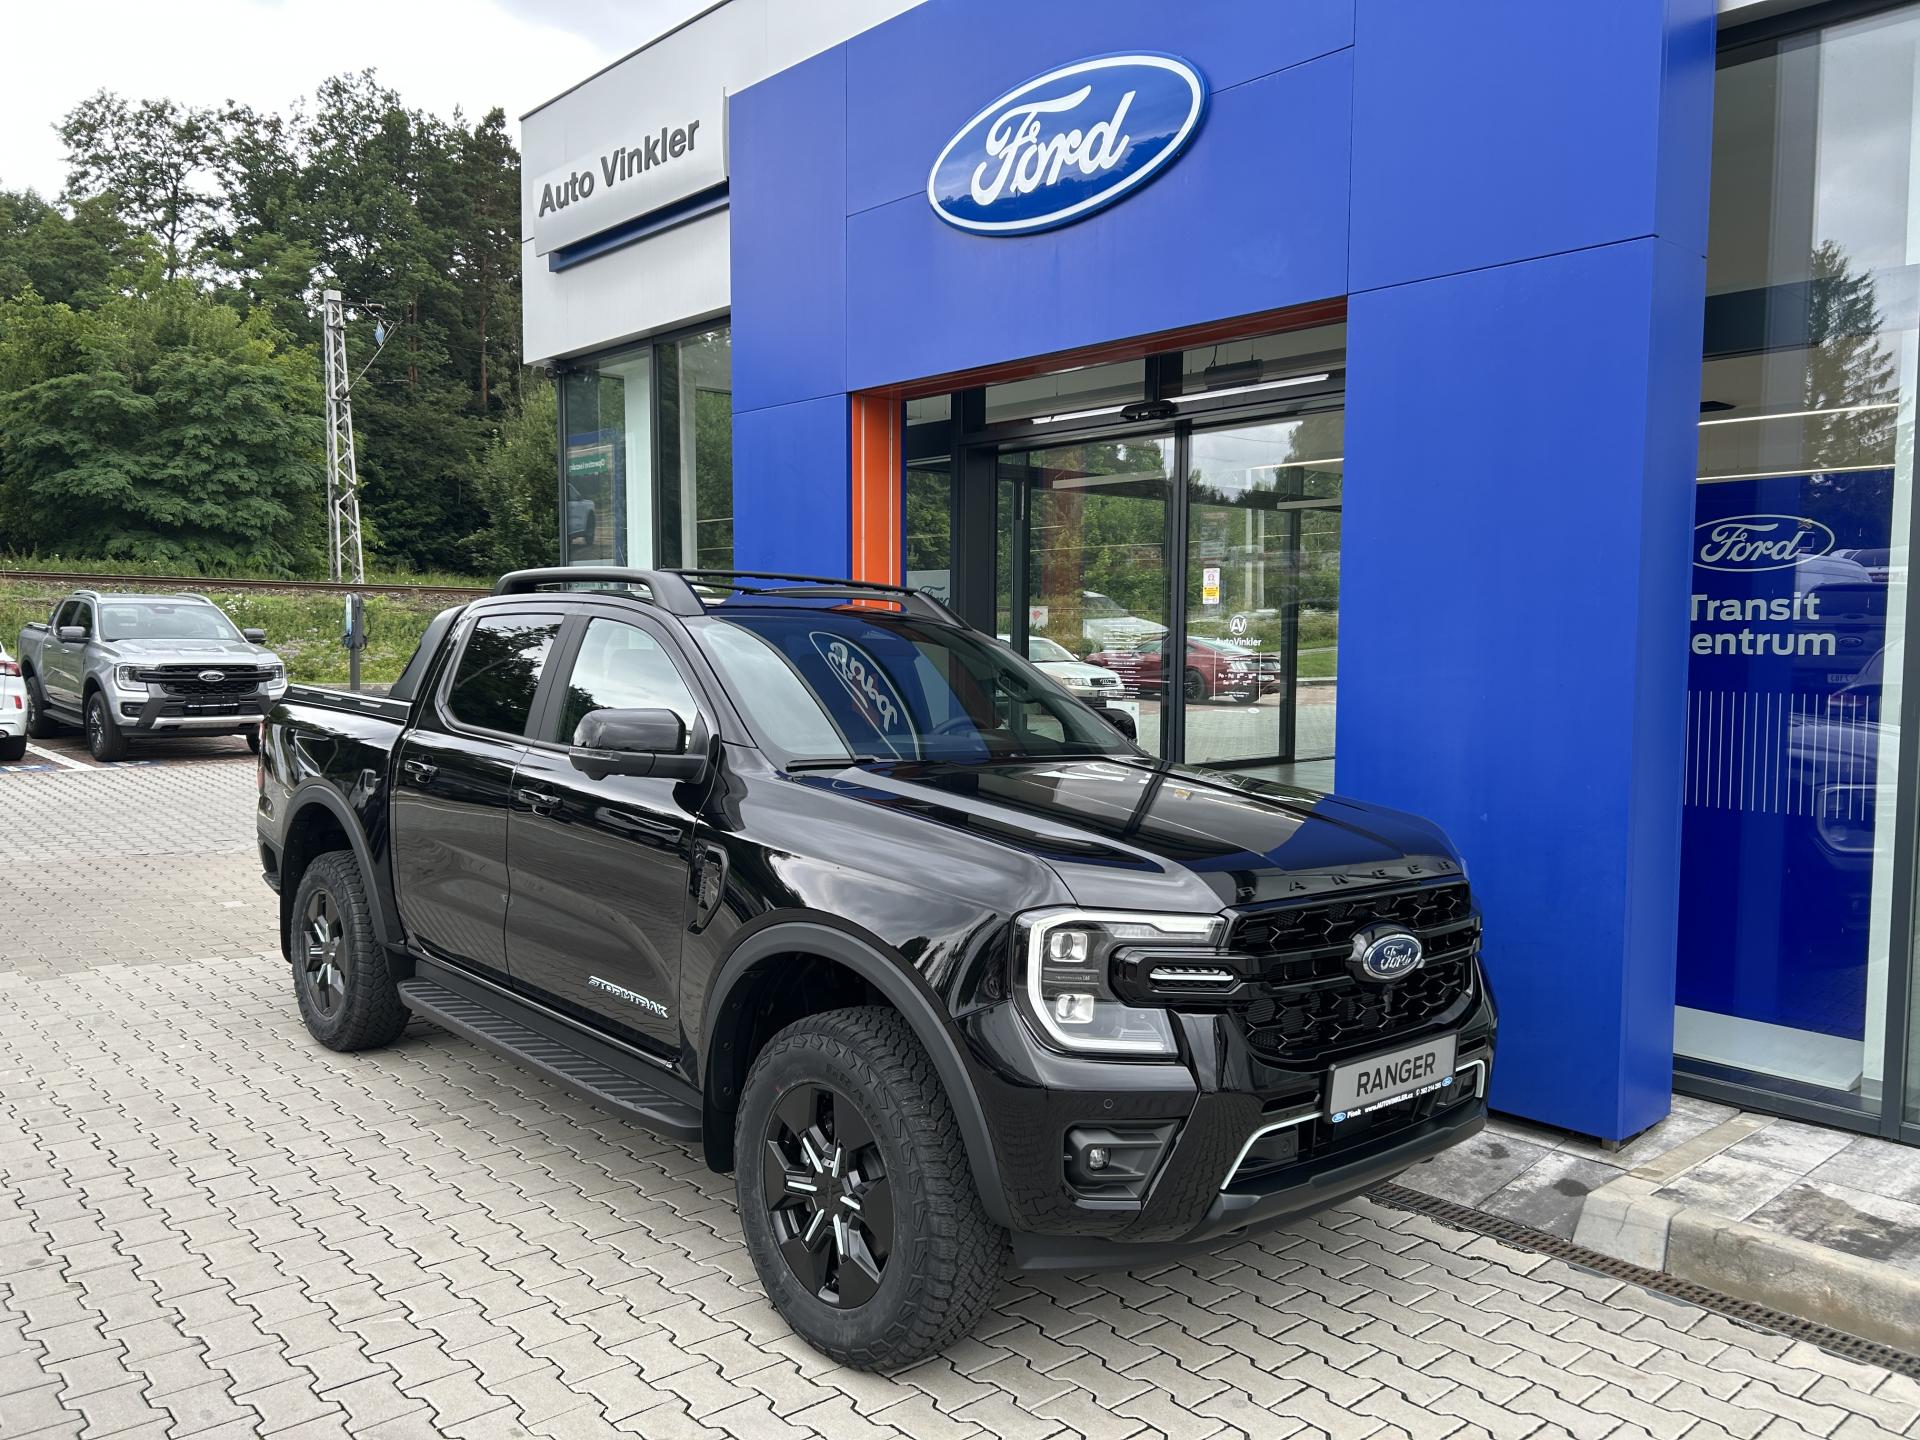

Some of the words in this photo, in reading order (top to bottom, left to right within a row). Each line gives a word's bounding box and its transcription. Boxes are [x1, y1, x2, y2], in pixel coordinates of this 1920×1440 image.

[971, 84, 1135, 205] Ford
[538, 170, 595, 217] Auto
[600, 119, 700, 187] Vinkler
[1700, 523, 1805, 562] Ford
[1690, 592, 1820, 621] Transit
[1690, 628, 1836, 656] entrum
[1380, 943, 1413, 971] Ford
[1356, 1051, 1436, 1098] RANGER
